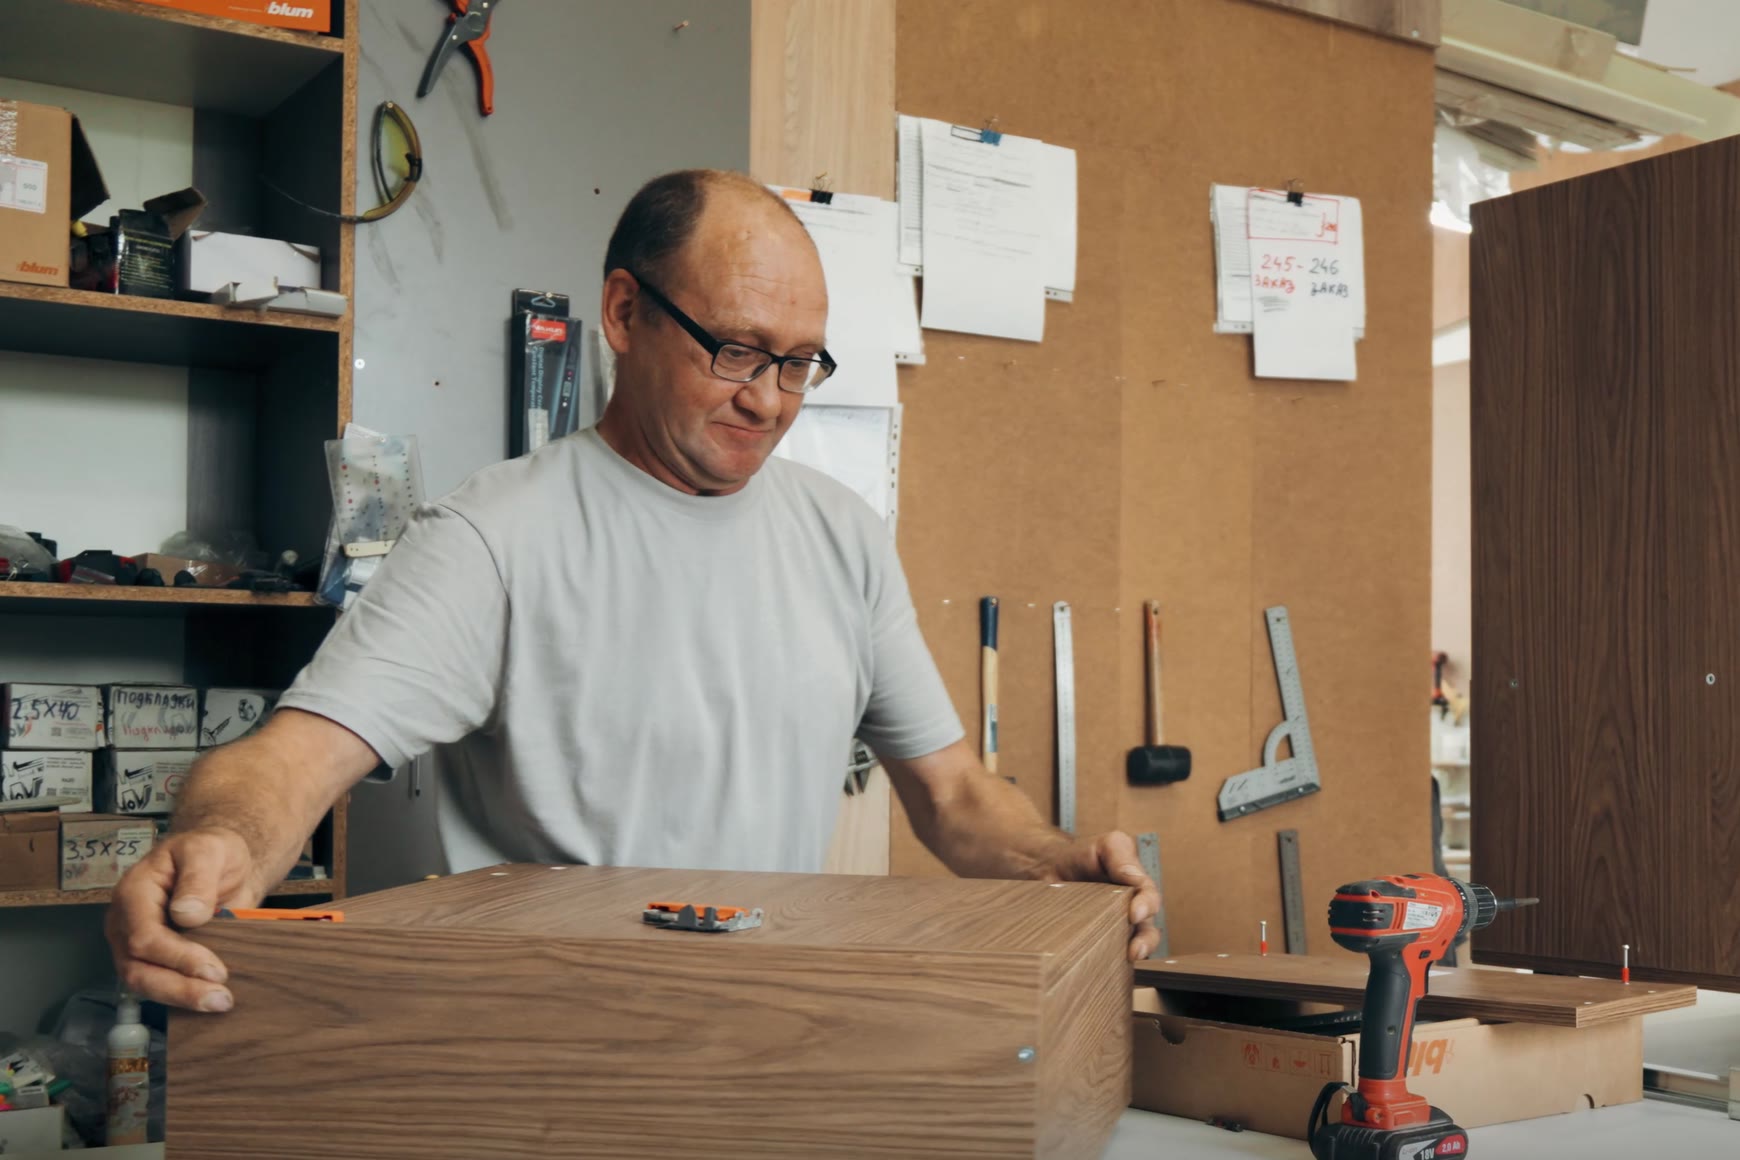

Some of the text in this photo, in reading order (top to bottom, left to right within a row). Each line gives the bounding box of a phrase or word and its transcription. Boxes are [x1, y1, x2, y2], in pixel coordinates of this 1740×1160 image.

[267, 1, 314, 19] blum
[19, 261, 59, 276] blum
[1309, 257, 1339, 275] 246
[1452, 1140, 1461, 1150] Ah
[1420, 1147, 1435, 1160] 18V
